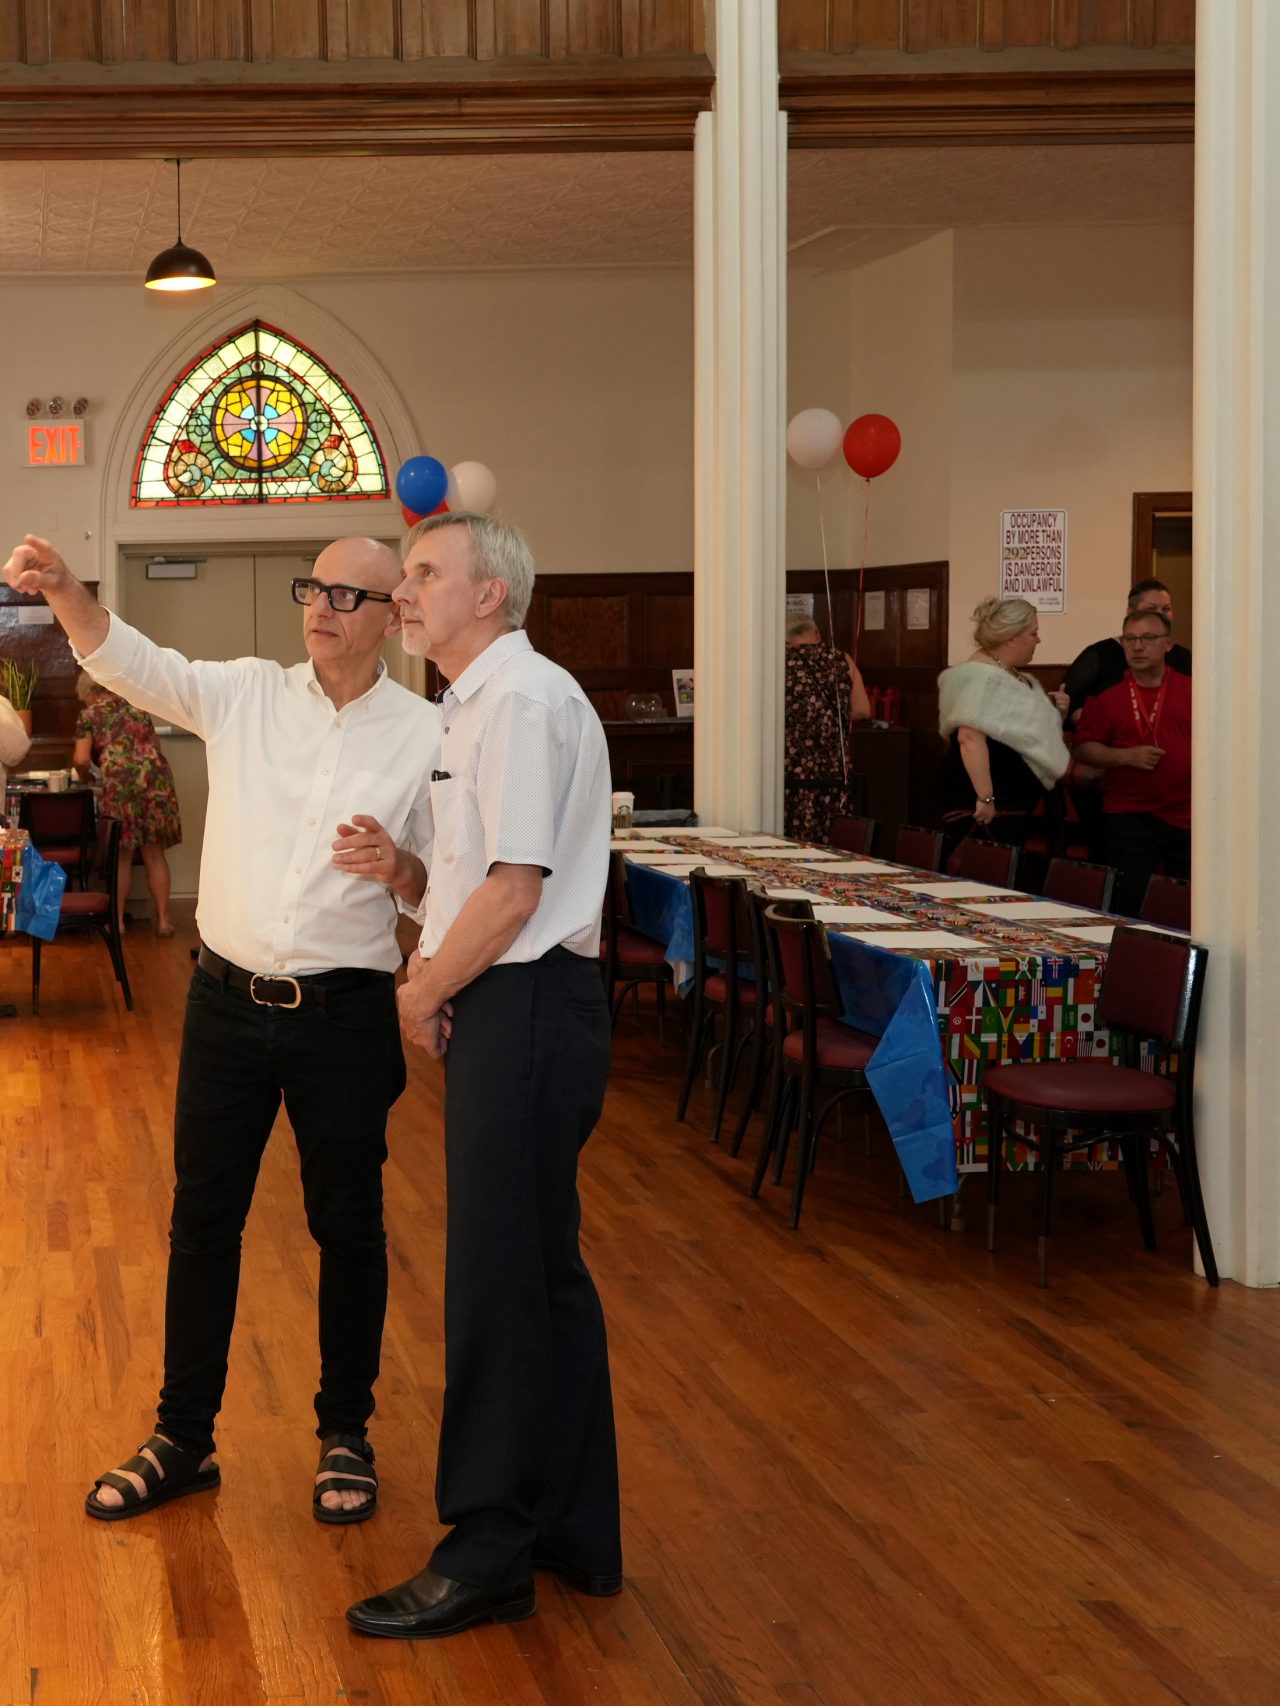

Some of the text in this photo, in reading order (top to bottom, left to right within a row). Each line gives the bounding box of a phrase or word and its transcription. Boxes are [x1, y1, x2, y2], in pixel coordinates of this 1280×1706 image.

[29, 425, 81, 464] EXIT
[1011, 513, 1057, 528] OCCUPANCY
[1006, 530, 1062, 544] BY MORE THAN
[1004, 546, 1061, 560] 292 PERSONS
[1005, 562, 1062, 577] IS DANGEROUS
[1004, 578, 1062, 592] AND UNLAWFUL
